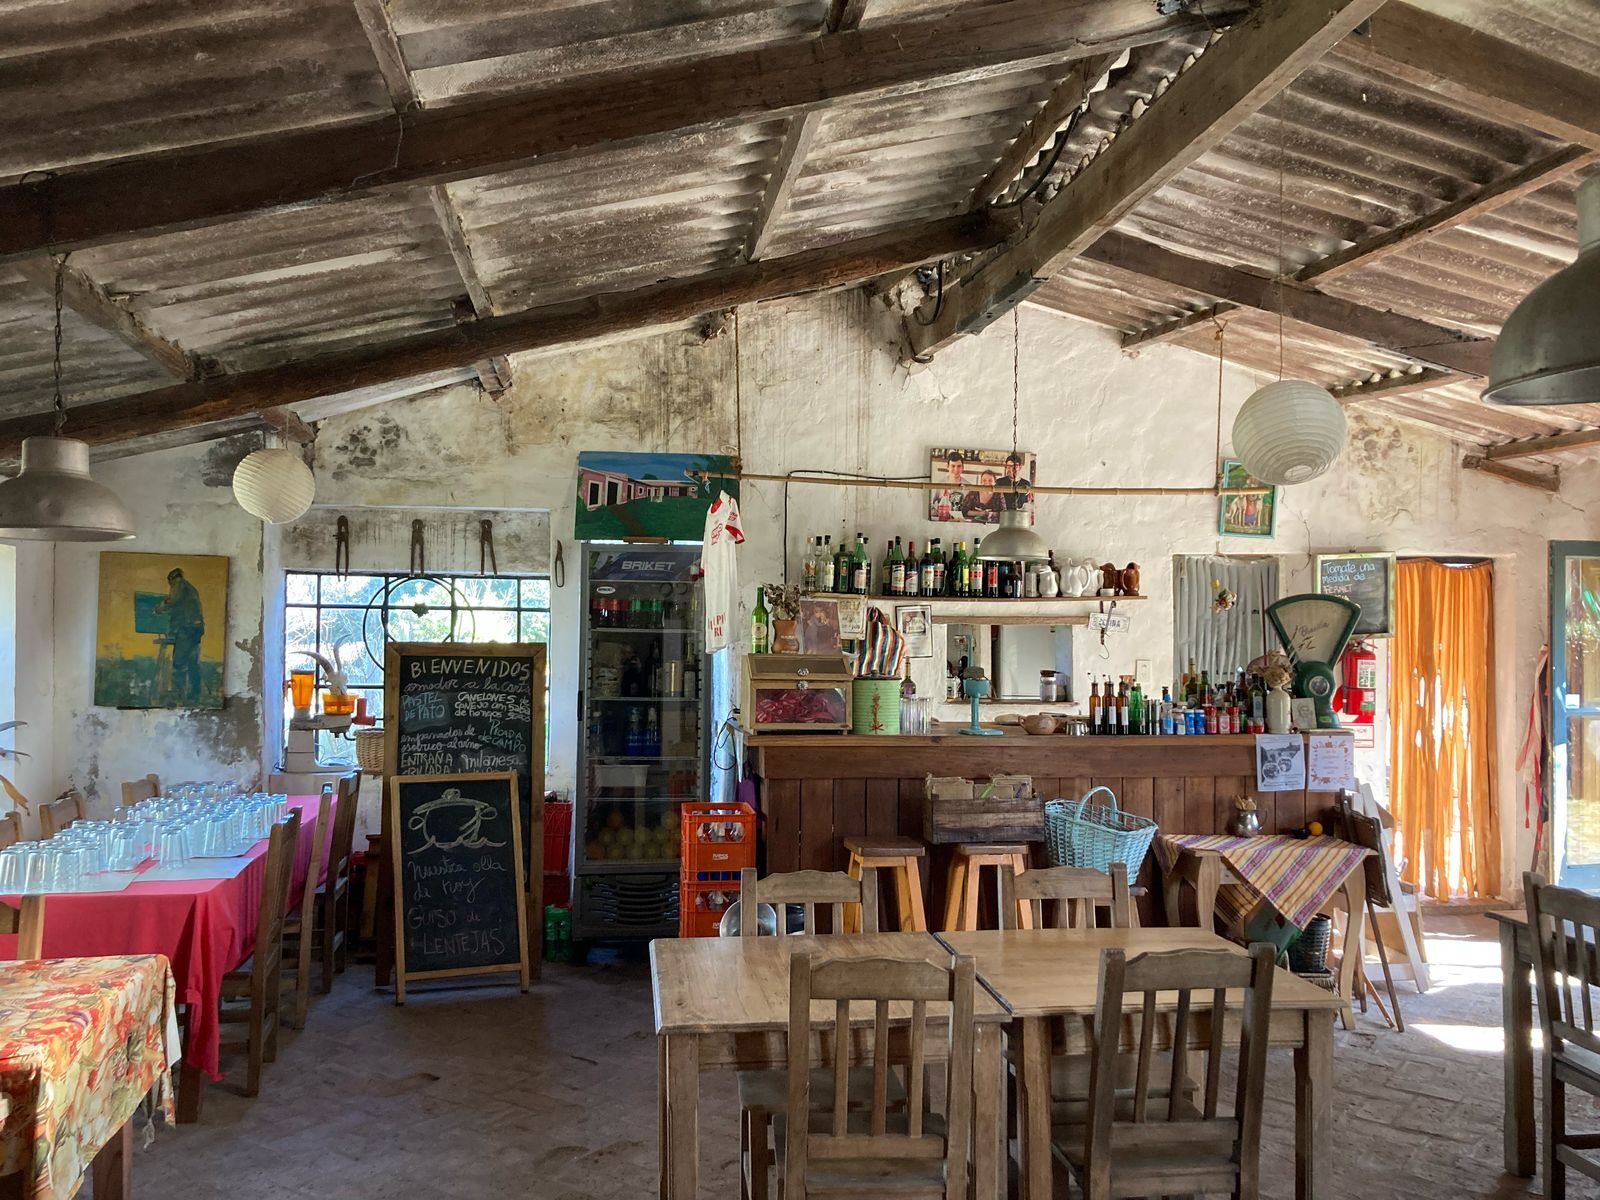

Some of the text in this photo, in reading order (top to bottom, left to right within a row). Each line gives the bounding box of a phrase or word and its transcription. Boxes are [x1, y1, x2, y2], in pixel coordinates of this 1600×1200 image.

[621, 560, 676, 571] BRIKET
[1323, 561, 1376, 575] Tomate una
[1322, 572, 1366, 584] medida de
[411, 658, 530, 680] BIENVENIDOS
[462, 681, 479, 690] a
[482, 677, 500, 691] la
[401, 691, 443, 710] PASTEL
[457, 692, 518, 705] CANELONES
[405, 704, 446, 720] DE PATO
[491, 738, 527, 753] CAMPO
[473, 855, 508, 872] olla
[423, 928, 505, 956] LENTEJAS
